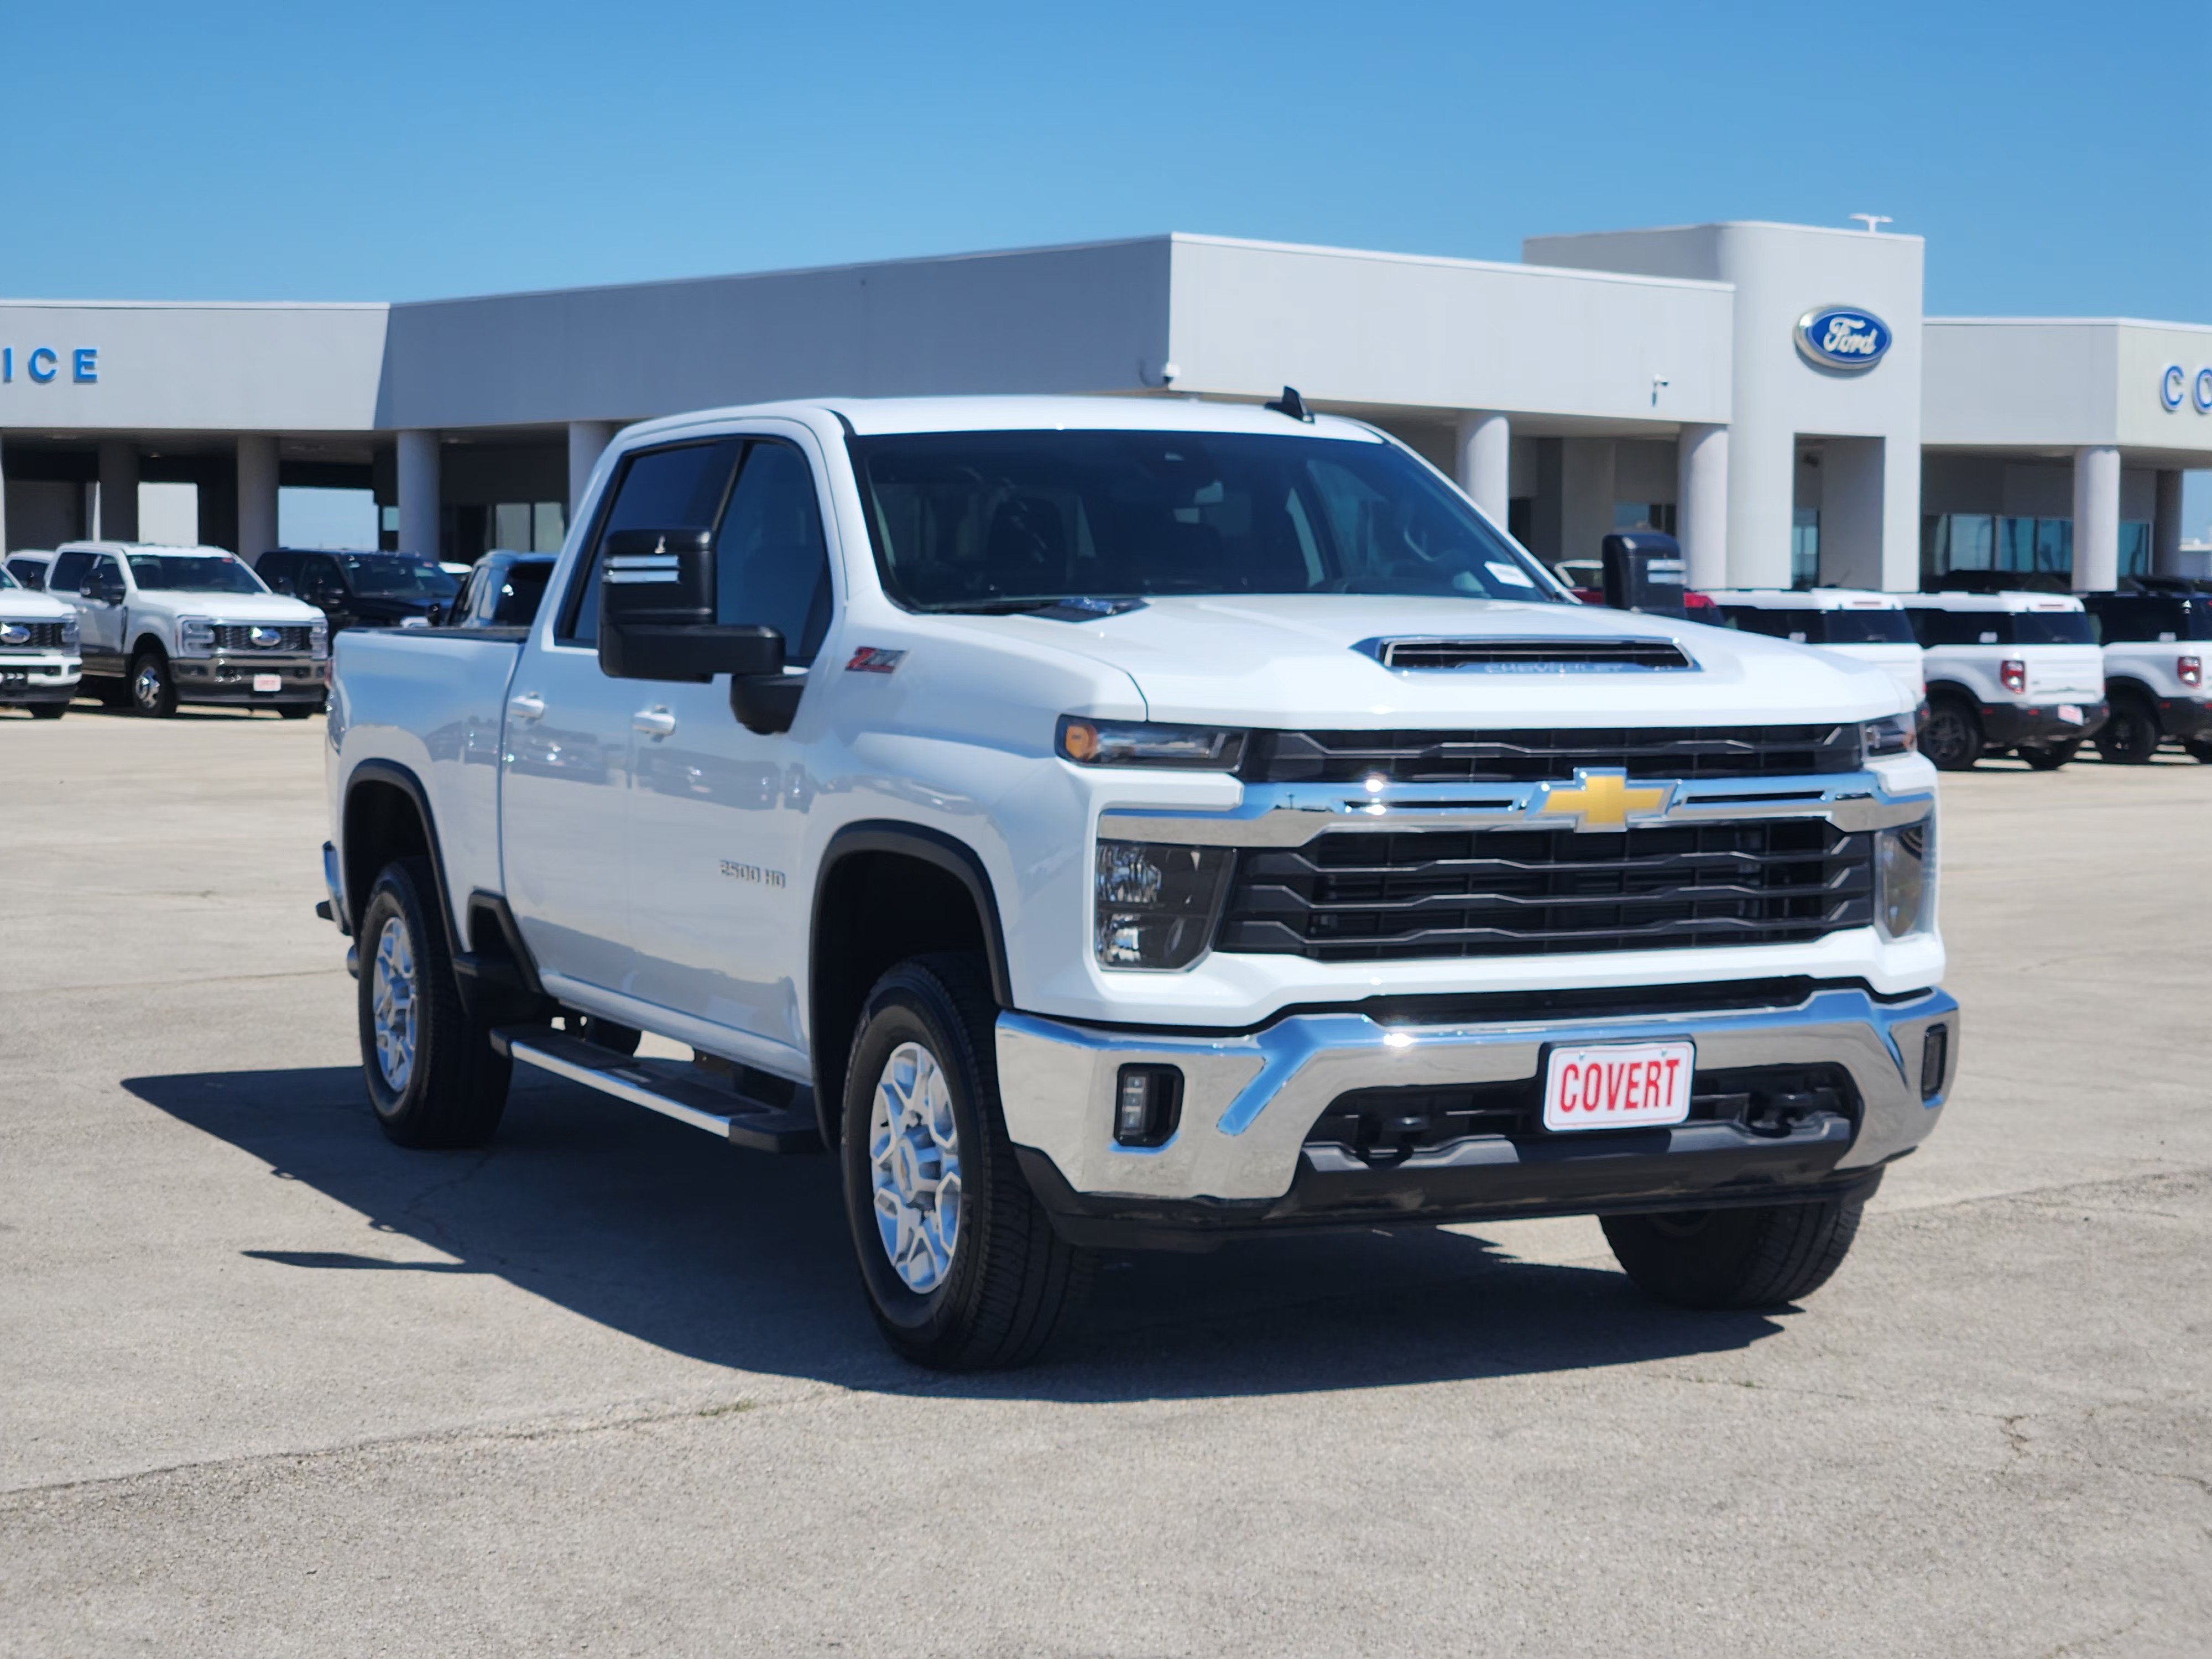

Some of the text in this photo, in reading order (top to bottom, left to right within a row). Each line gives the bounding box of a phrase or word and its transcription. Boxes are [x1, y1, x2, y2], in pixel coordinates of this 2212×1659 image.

[1823, 316, 1877, 354] Ford
[3, 347, 98, 383] ICE
[719, 859, 786, 889] 2500 HD
[1559, 1058, 1681, 1113] COVERT
